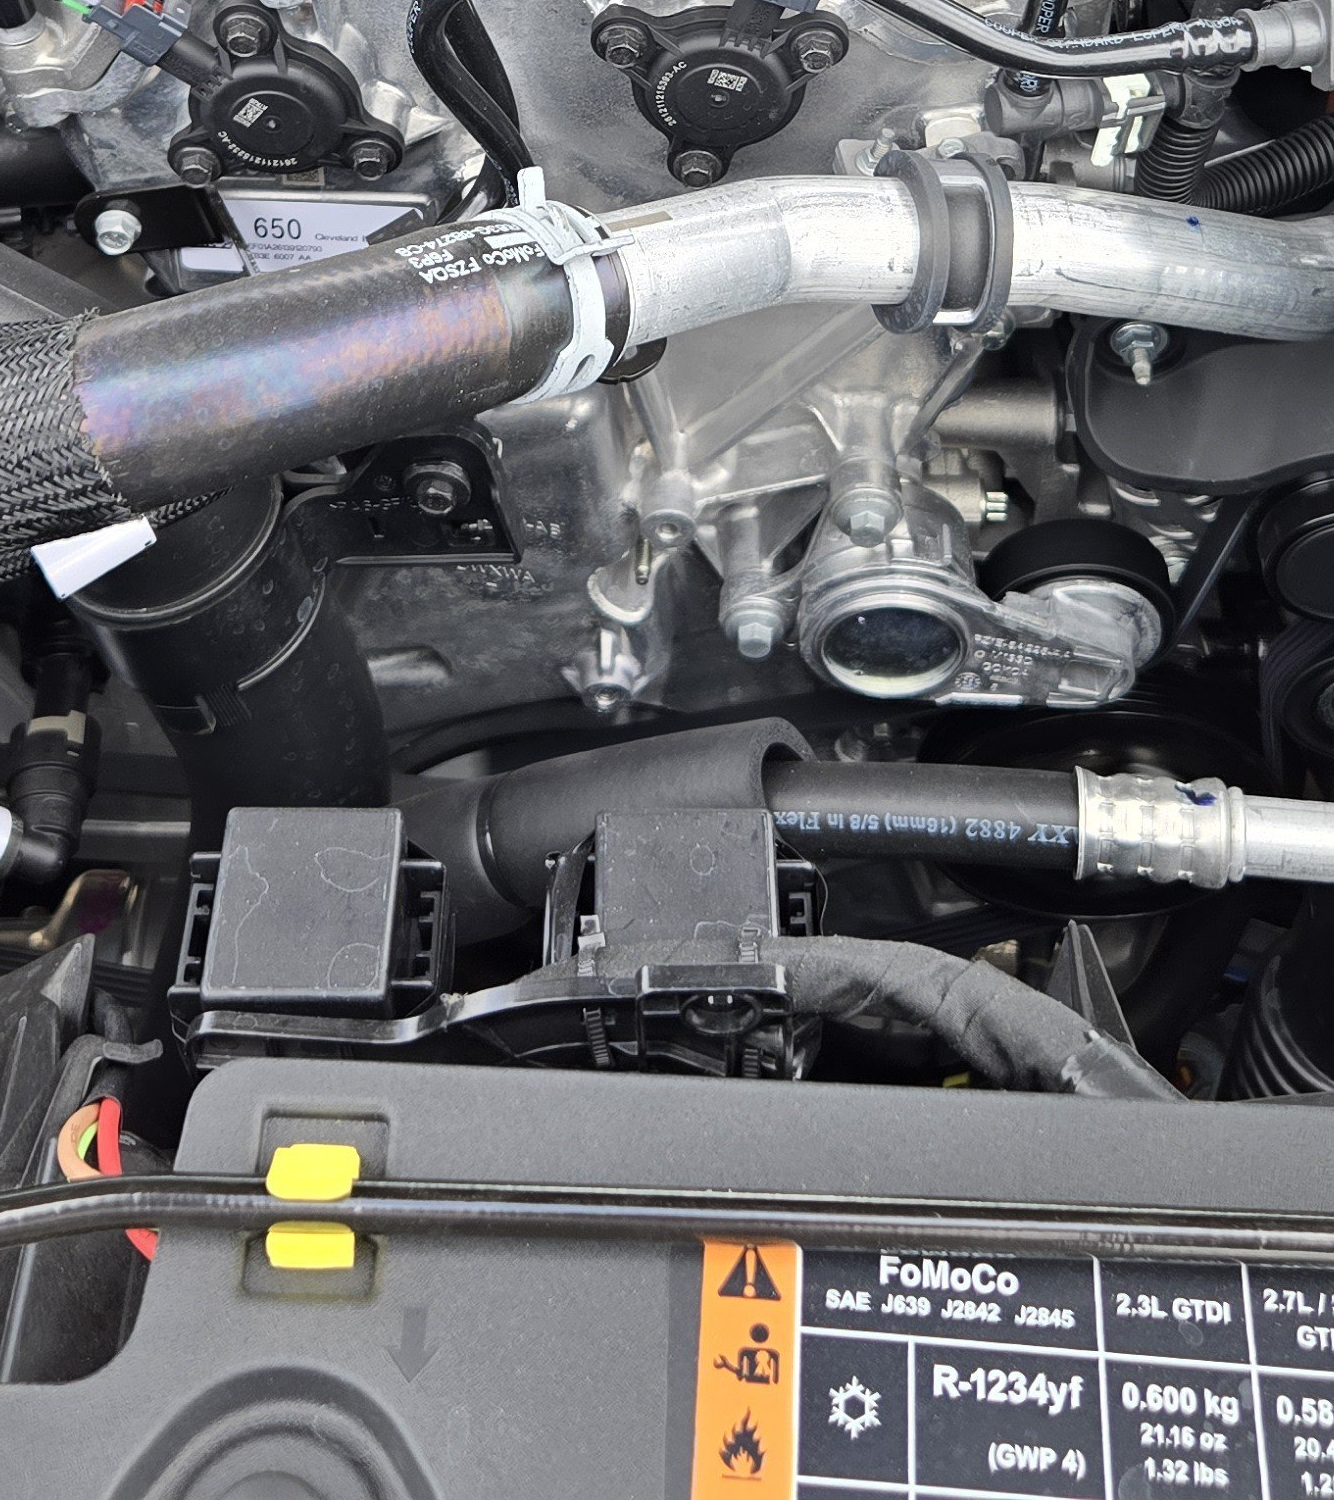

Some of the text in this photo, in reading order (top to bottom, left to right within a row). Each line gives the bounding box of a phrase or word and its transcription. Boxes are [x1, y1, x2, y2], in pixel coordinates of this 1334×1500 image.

[253, 217, 302, 240] 650
[315, 233, 359, 242] Cleveland
[273, 253, 294, 261] 6007
[408, 249, 454, 269] F6P3
[482, 243, 546, 266] FoMoCo
[773, 811, 821, 831] Flex
[849, 813, 880, 831] 5/8
[884, 812, 957, 835] (16mm)
[965, 818, 1022, 841] 4882
[879, 1255, 1019, 1296] FoMoCo
[825, 1288, 1075, 1329] SAE J639 J2842 J2845
[1116, 1293, 1232, 1325] 2.3L GTDI
[1263, 1288, 1315, 1314] 2.7L
[1318, 1292, 1327, 1316] /
[932, 1363, 1085, 1416] R-1234yf
[1122, 1382, 1240, 1426] 0.600 kg
[1139, 1422, 1229, 1453] 21.16 oz
[987, 1442, 1087, 1482] (GWP 4)
[1143, 1457, 1230, 1487] 1.32 lbs
